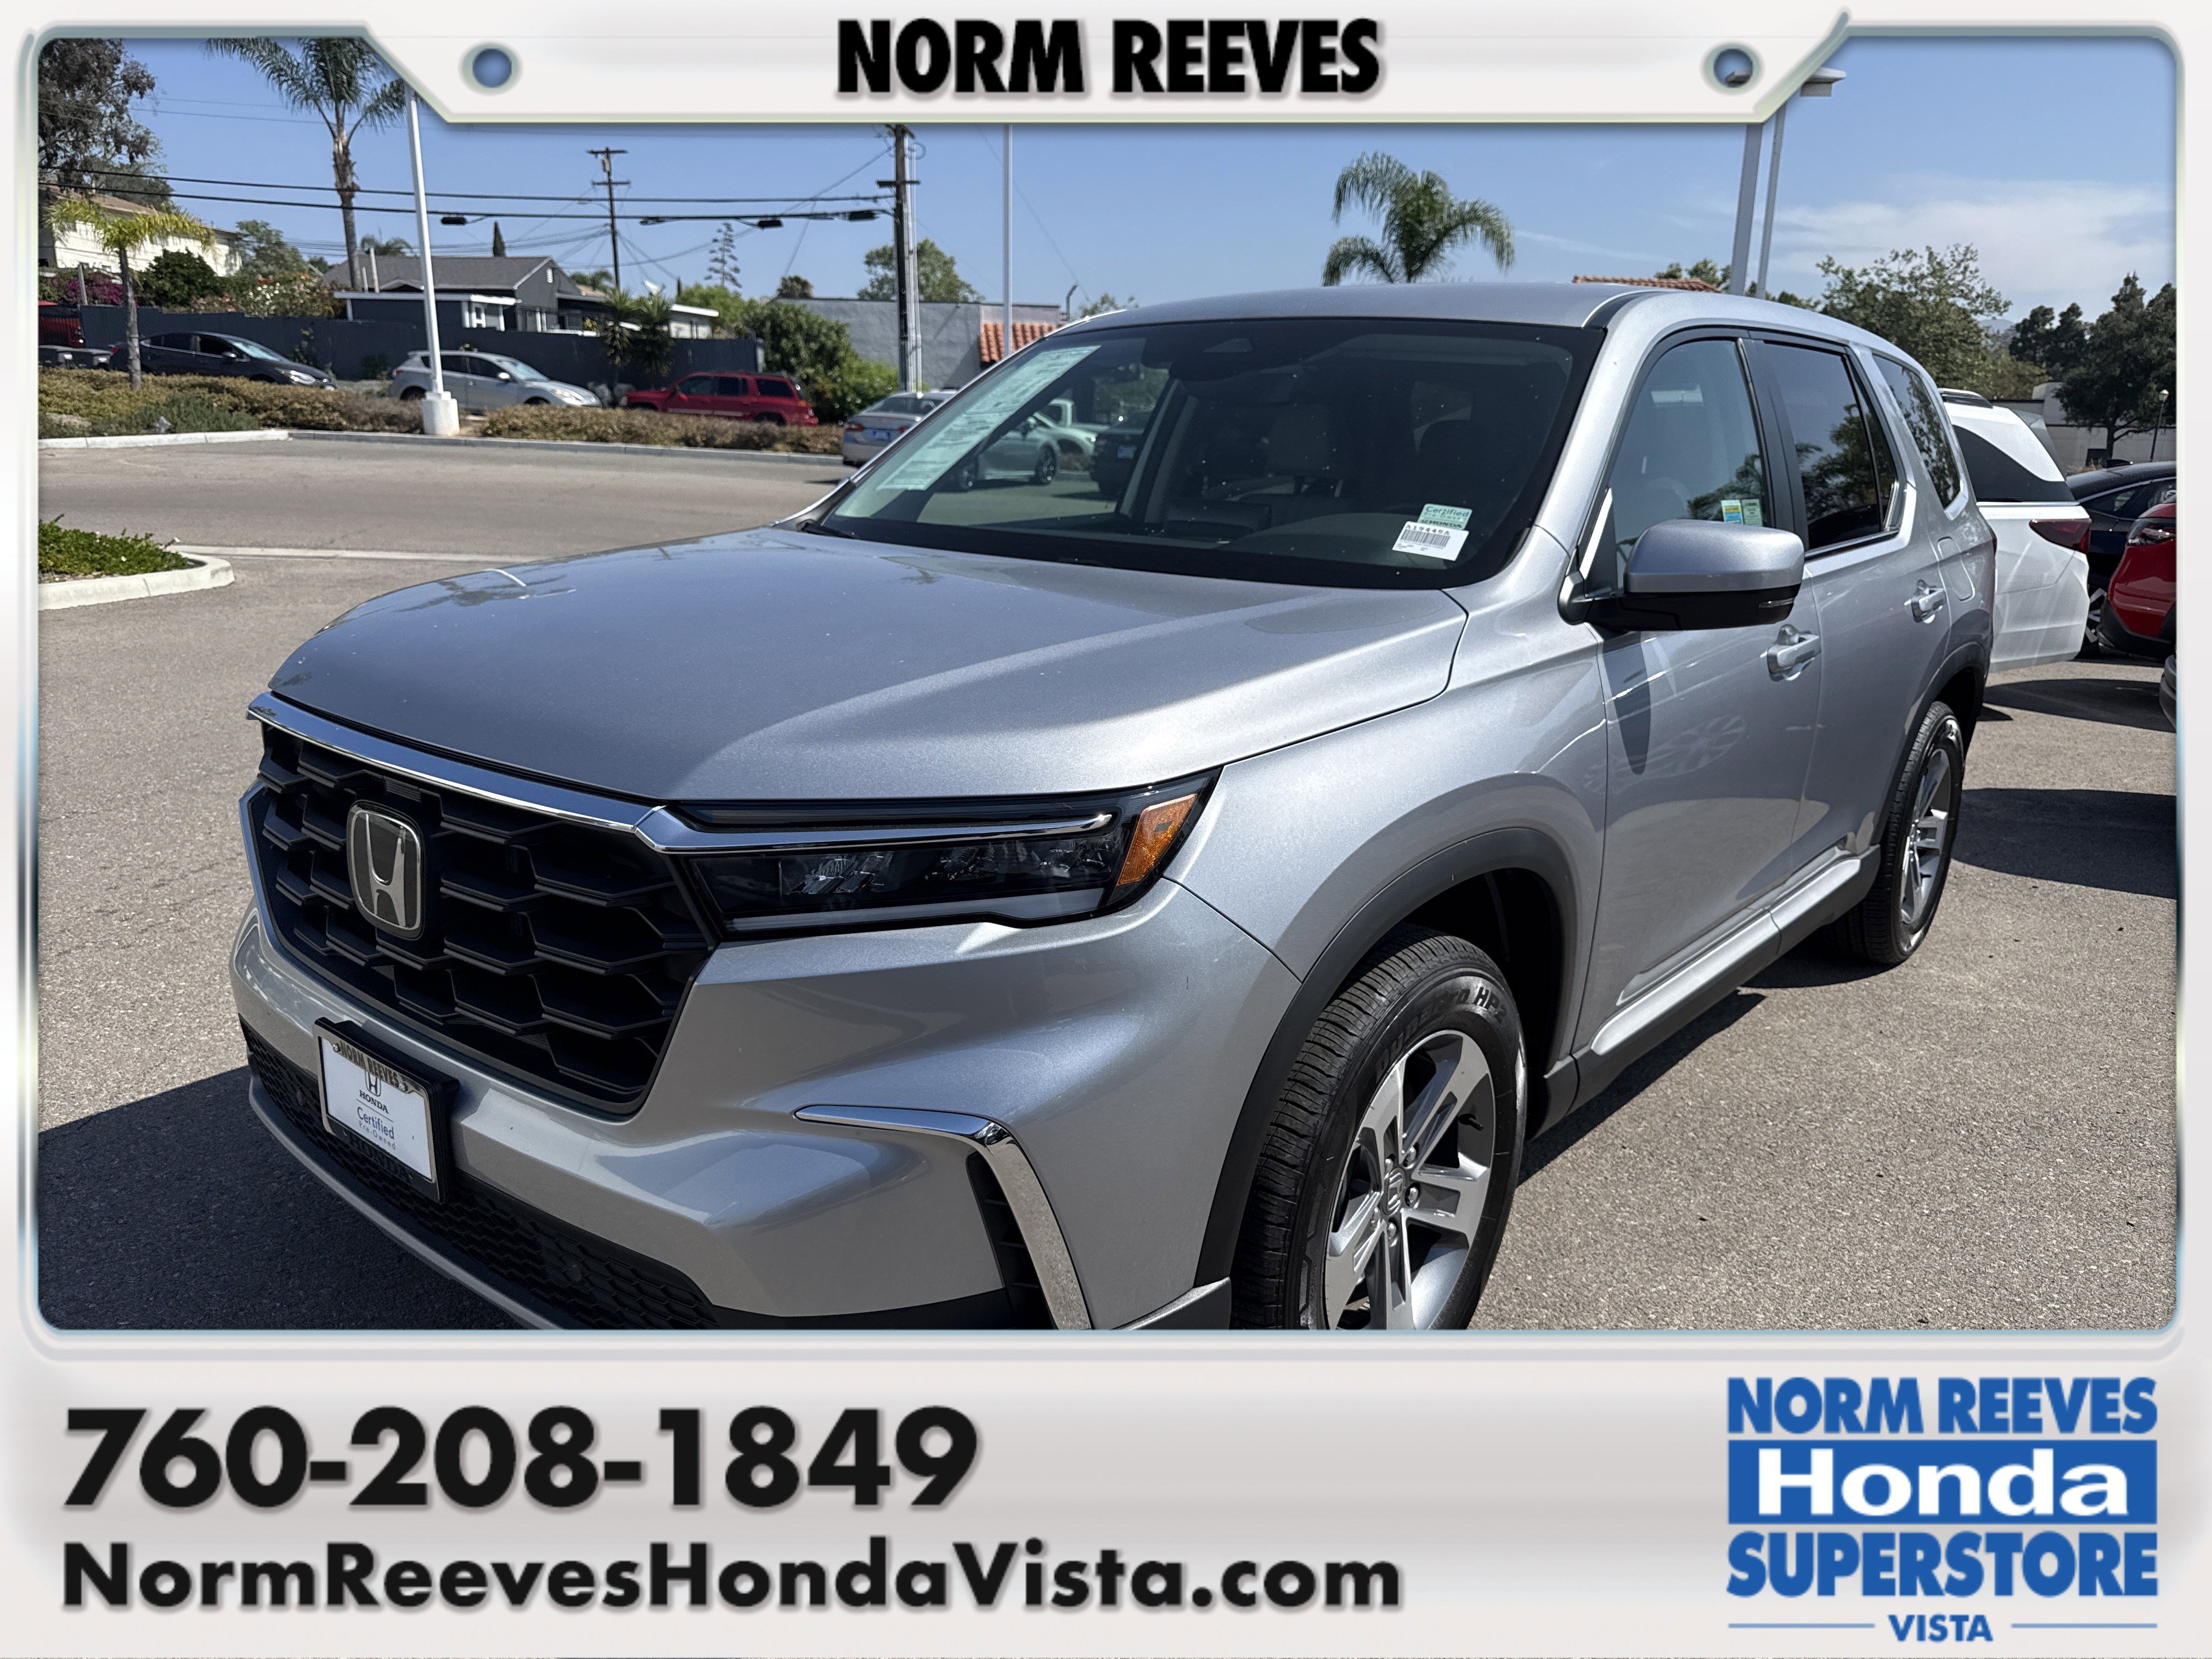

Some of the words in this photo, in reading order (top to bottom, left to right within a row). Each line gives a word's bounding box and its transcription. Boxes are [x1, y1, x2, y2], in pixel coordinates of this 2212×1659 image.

[1426, 506, 1470, 517] Certified
[340, 1040, 366, 1070] NORM
[366, 1057, 400, 1089] REEVES
[359, 1090, 390, 1114] HONDA
[357, 1107, 394, 1140] Certified
